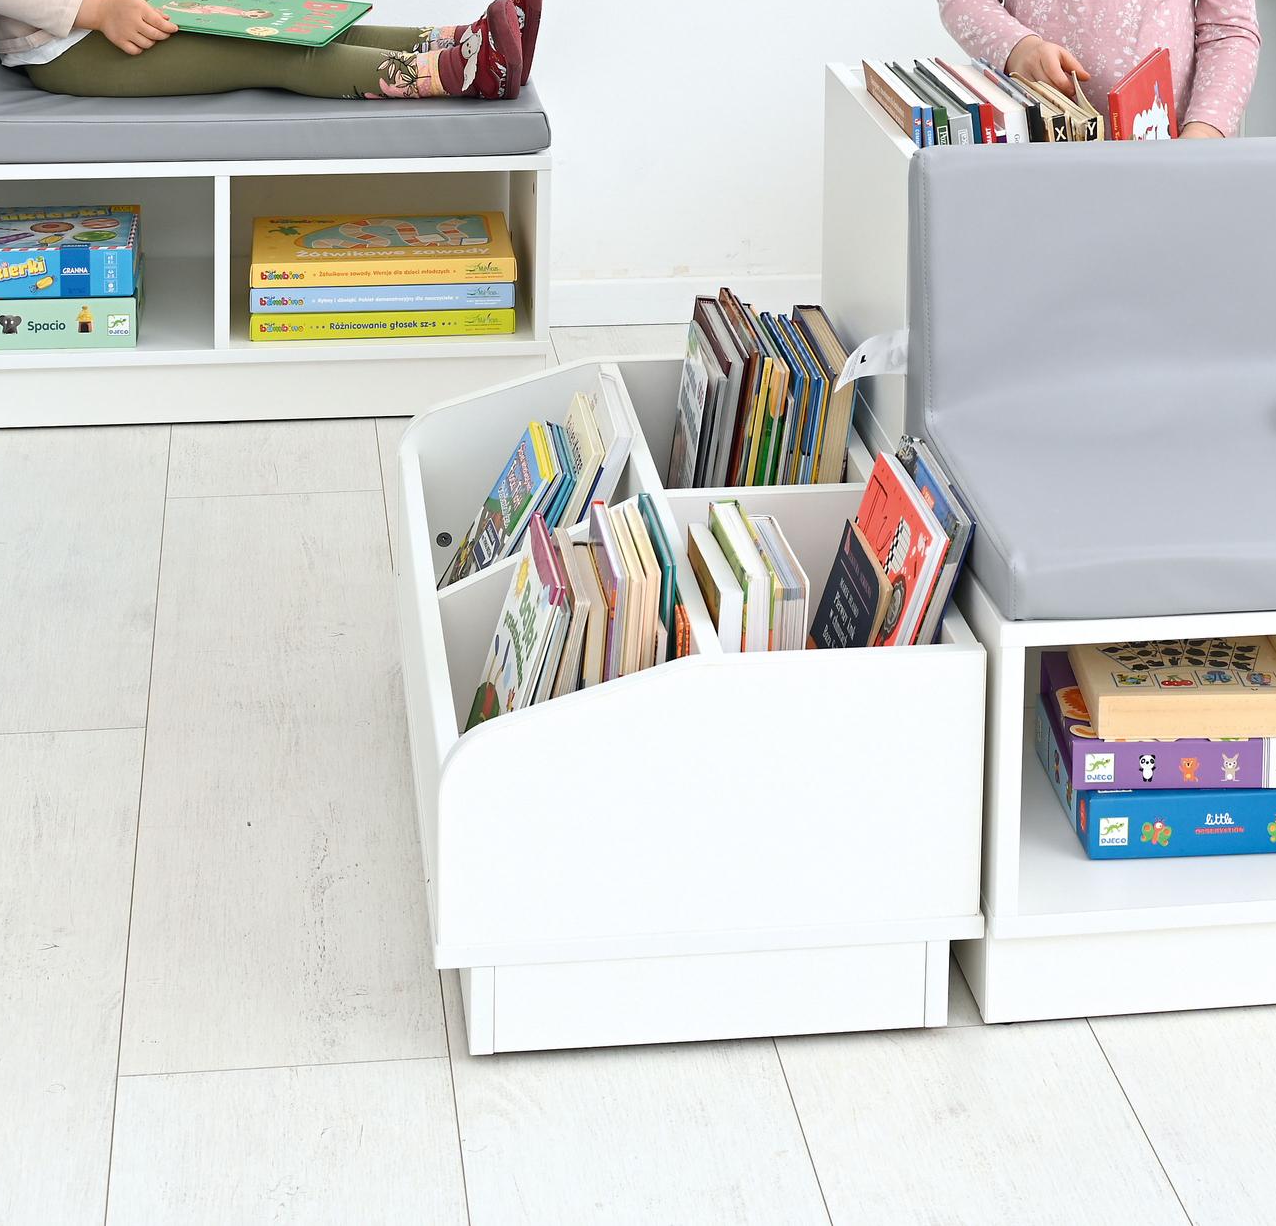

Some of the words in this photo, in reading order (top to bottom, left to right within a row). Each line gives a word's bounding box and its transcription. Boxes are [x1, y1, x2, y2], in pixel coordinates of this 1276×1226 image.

[27, 320, 66, 334] Spacio
[329, 321, 387, 331] Różnicowanie
[389, 320, 418, 330] głosek
[1204, 812, 1235, 826] little
